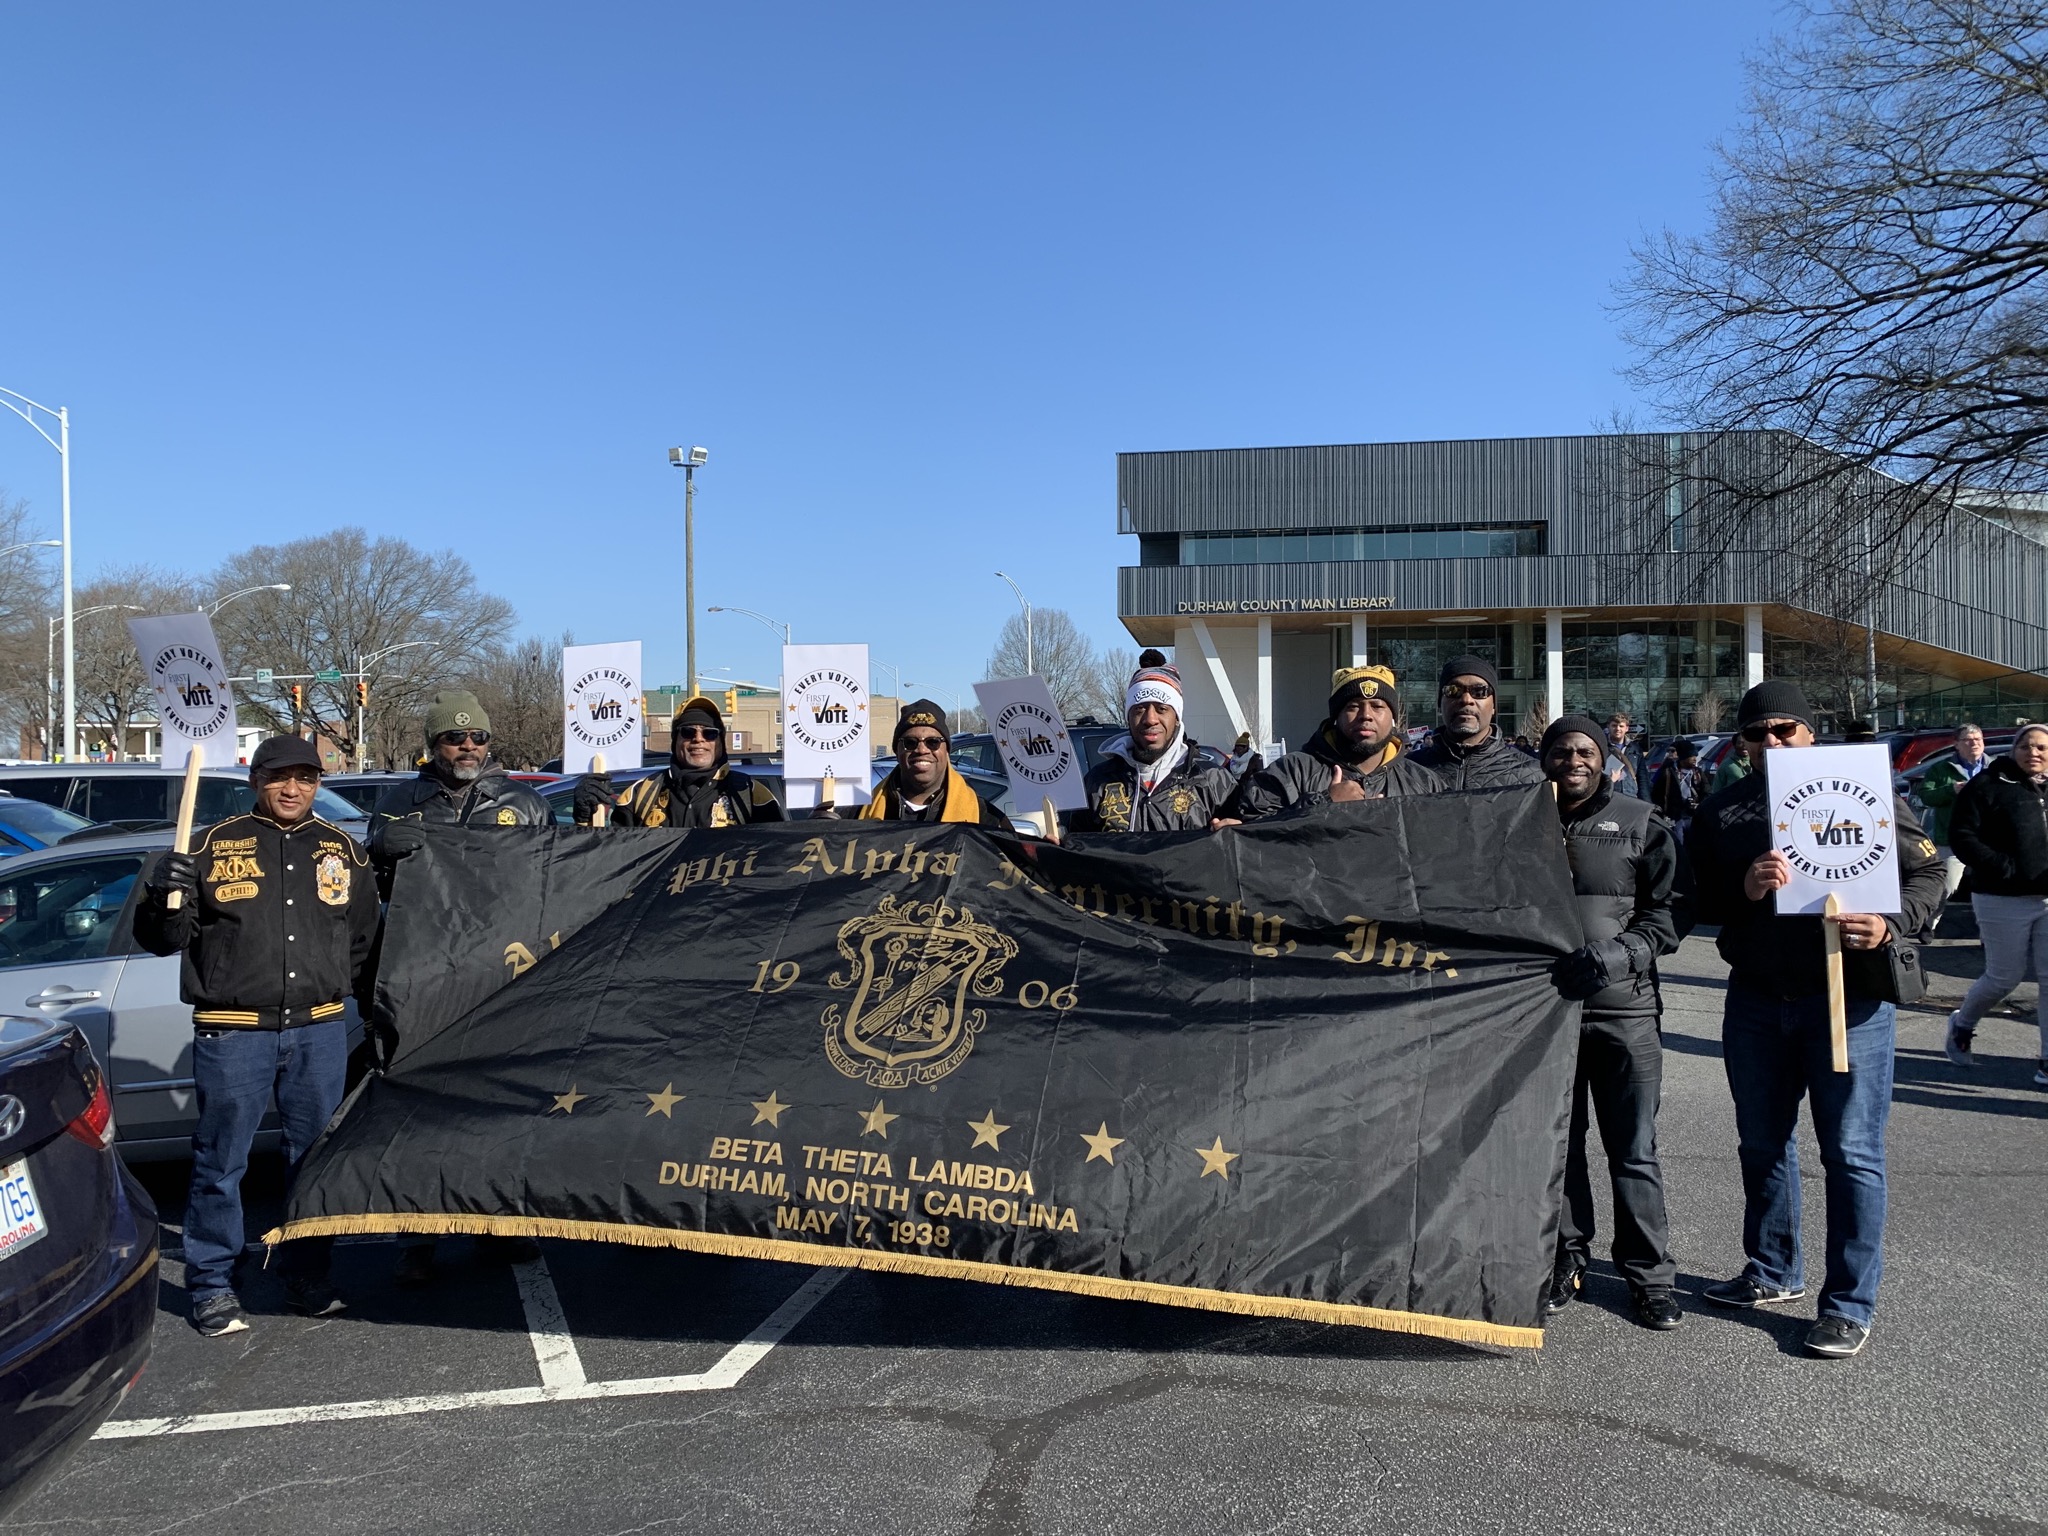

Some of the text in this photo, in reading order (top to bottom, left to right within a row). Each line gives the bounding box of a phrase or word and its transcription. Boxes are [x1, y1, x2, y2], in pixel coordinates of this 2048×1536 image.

[1179, 597, 1396, 612] DURHAM COUNTY MAIN LIBRARY
[155, 648, 213, 674] EVERY VOTER
[182, 674, 214, 706] VOTE
[573, 670, 632, 694] EVERY VOTER
[584, 692, 602, 700] FIRST
[794, 672, 859, 694] EVERY VOTER
[1134, 688, 1171, 703] BED-STUY
[592, 692, 622, 720] VOTE
[806, 694, 826, 702] FIRST
[815, 695, 848, 723] VOTE
[165, 704, 228, 737] EVERY ELECTION
[998, 704, 1051, 729] EVERY VOTER
[570, 717, 635, 746] EVERY ELECTION
[791, 722, 863, 750] EVERY ELECTION
[1010, 727, 1028, 736] FIRST
[1024, 727, 1055, 756] VOTE
[1009, 752, 1069, 782] EVERY ELECTION
[1784, 781, 1876, 810] EVERY VOTER
[1802, 809, 1830, 819] FIRST
[1810, 824, 1823, 832] WE
[1815, 809, 1864, 845] VOTE
[212, 838, 257, 850] LEADERSHIP
[666, 850, 759, 896] Phi
[786, 837, 961, 883] Alpha
[1783, 844, 1886, 879] EVERY ELECTION
[898, 960, 929, 971] 1906
[748, 960, 1080, 1011] 19 06
[710, 1136, 1034, 1196] BETA THETA LAMBDA
[659, 1161, 1079, 1233] DURHAM, NORTH CAROLINA
[776, 1206, 950, 1247] MAY 7, 1938
